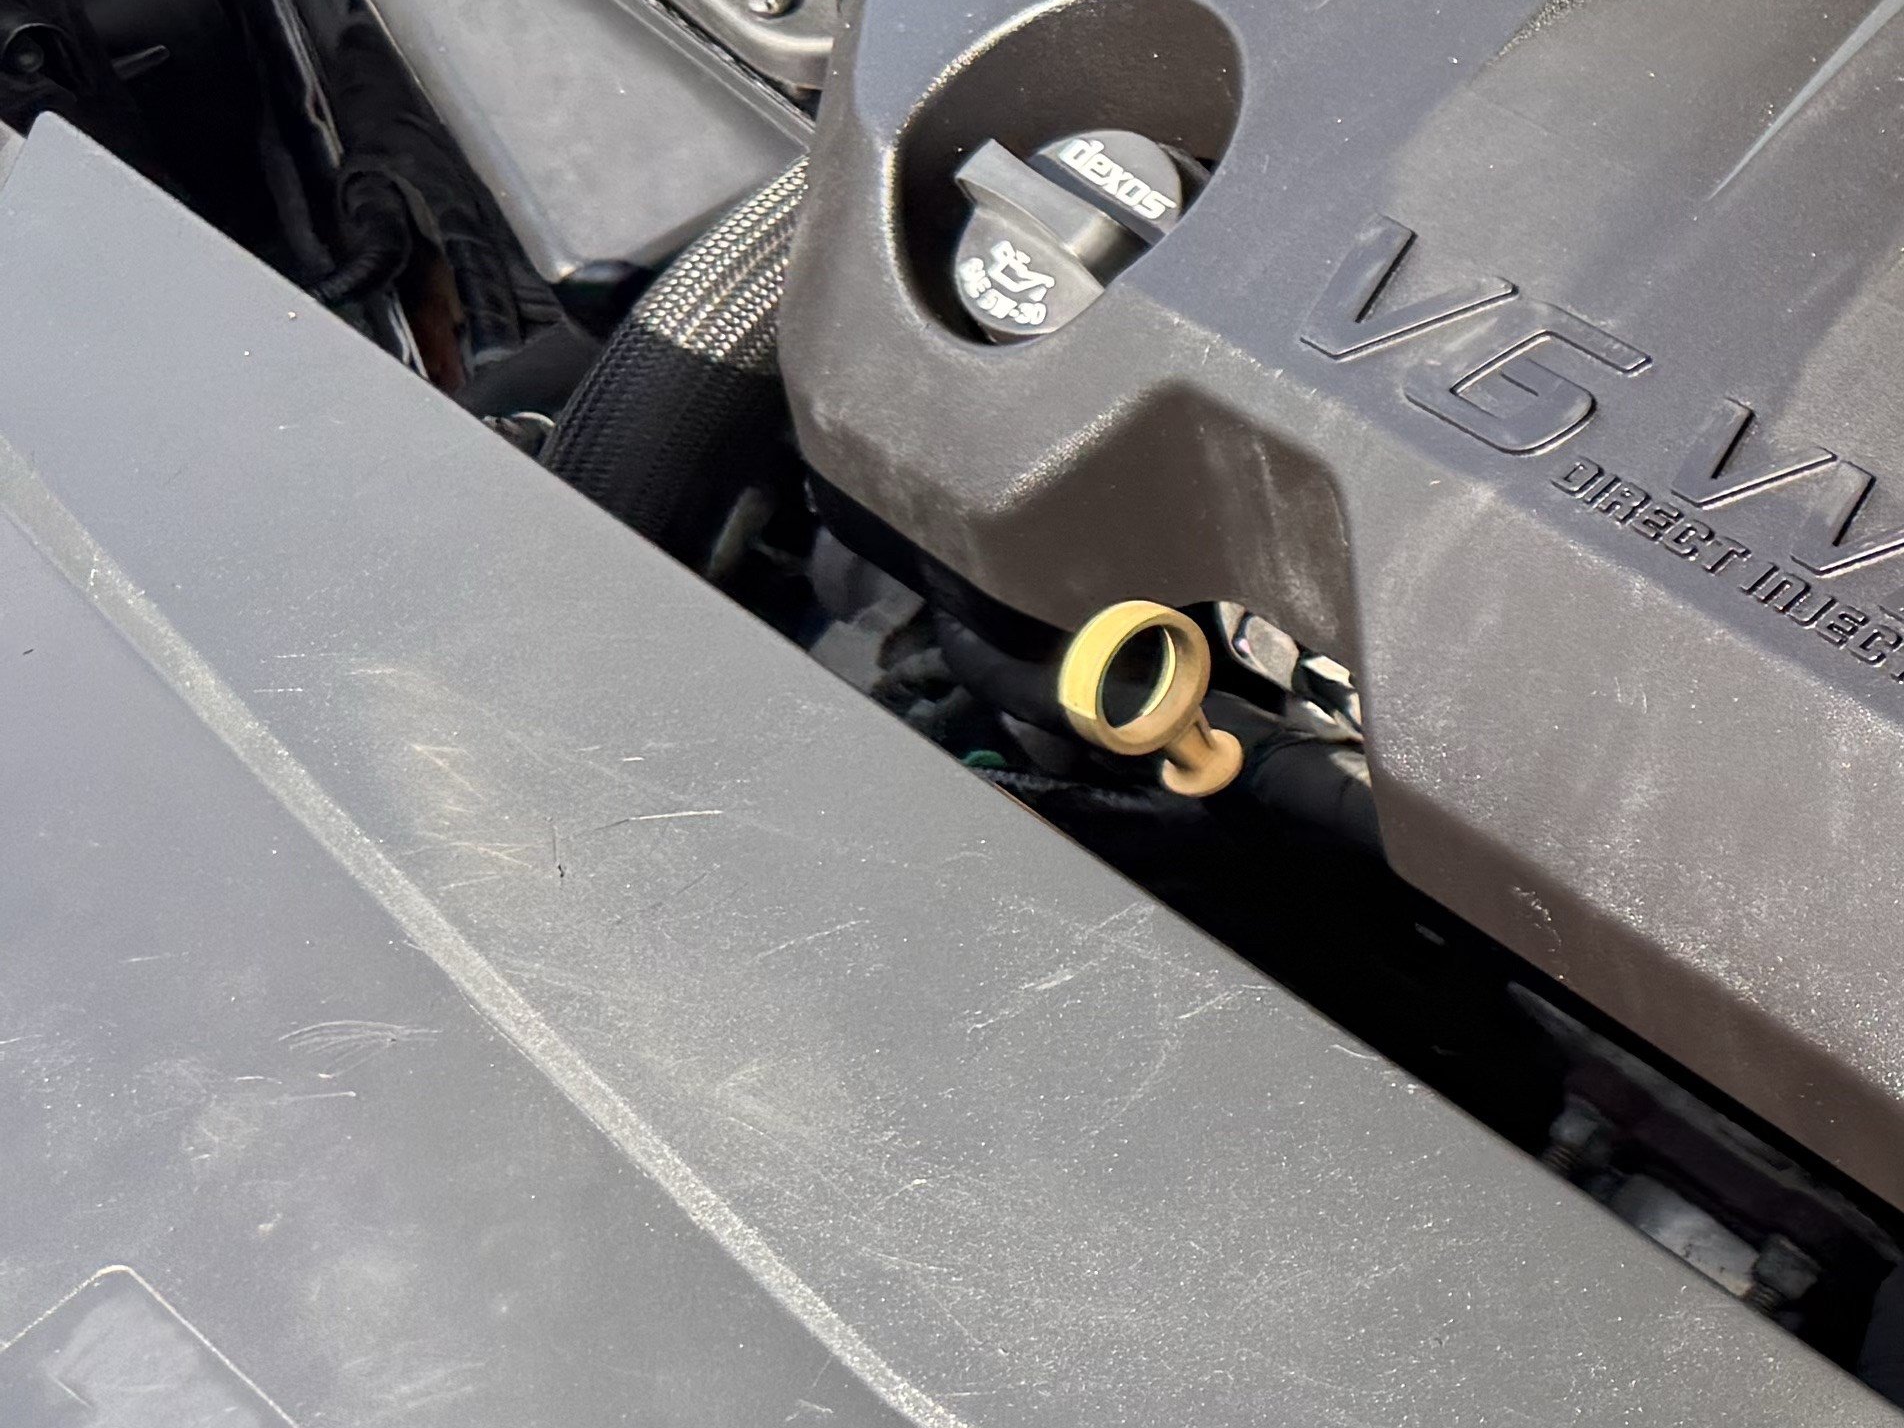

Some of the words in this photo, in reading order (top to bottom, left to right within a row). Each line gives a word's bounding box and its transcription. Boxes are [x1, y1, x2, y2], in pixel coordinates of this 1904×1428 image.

[1058, 138, 1177, 220] dexos
[1299, 214, 1652, 456] V6
[1549, 457, 1754, 575] DIRECT
